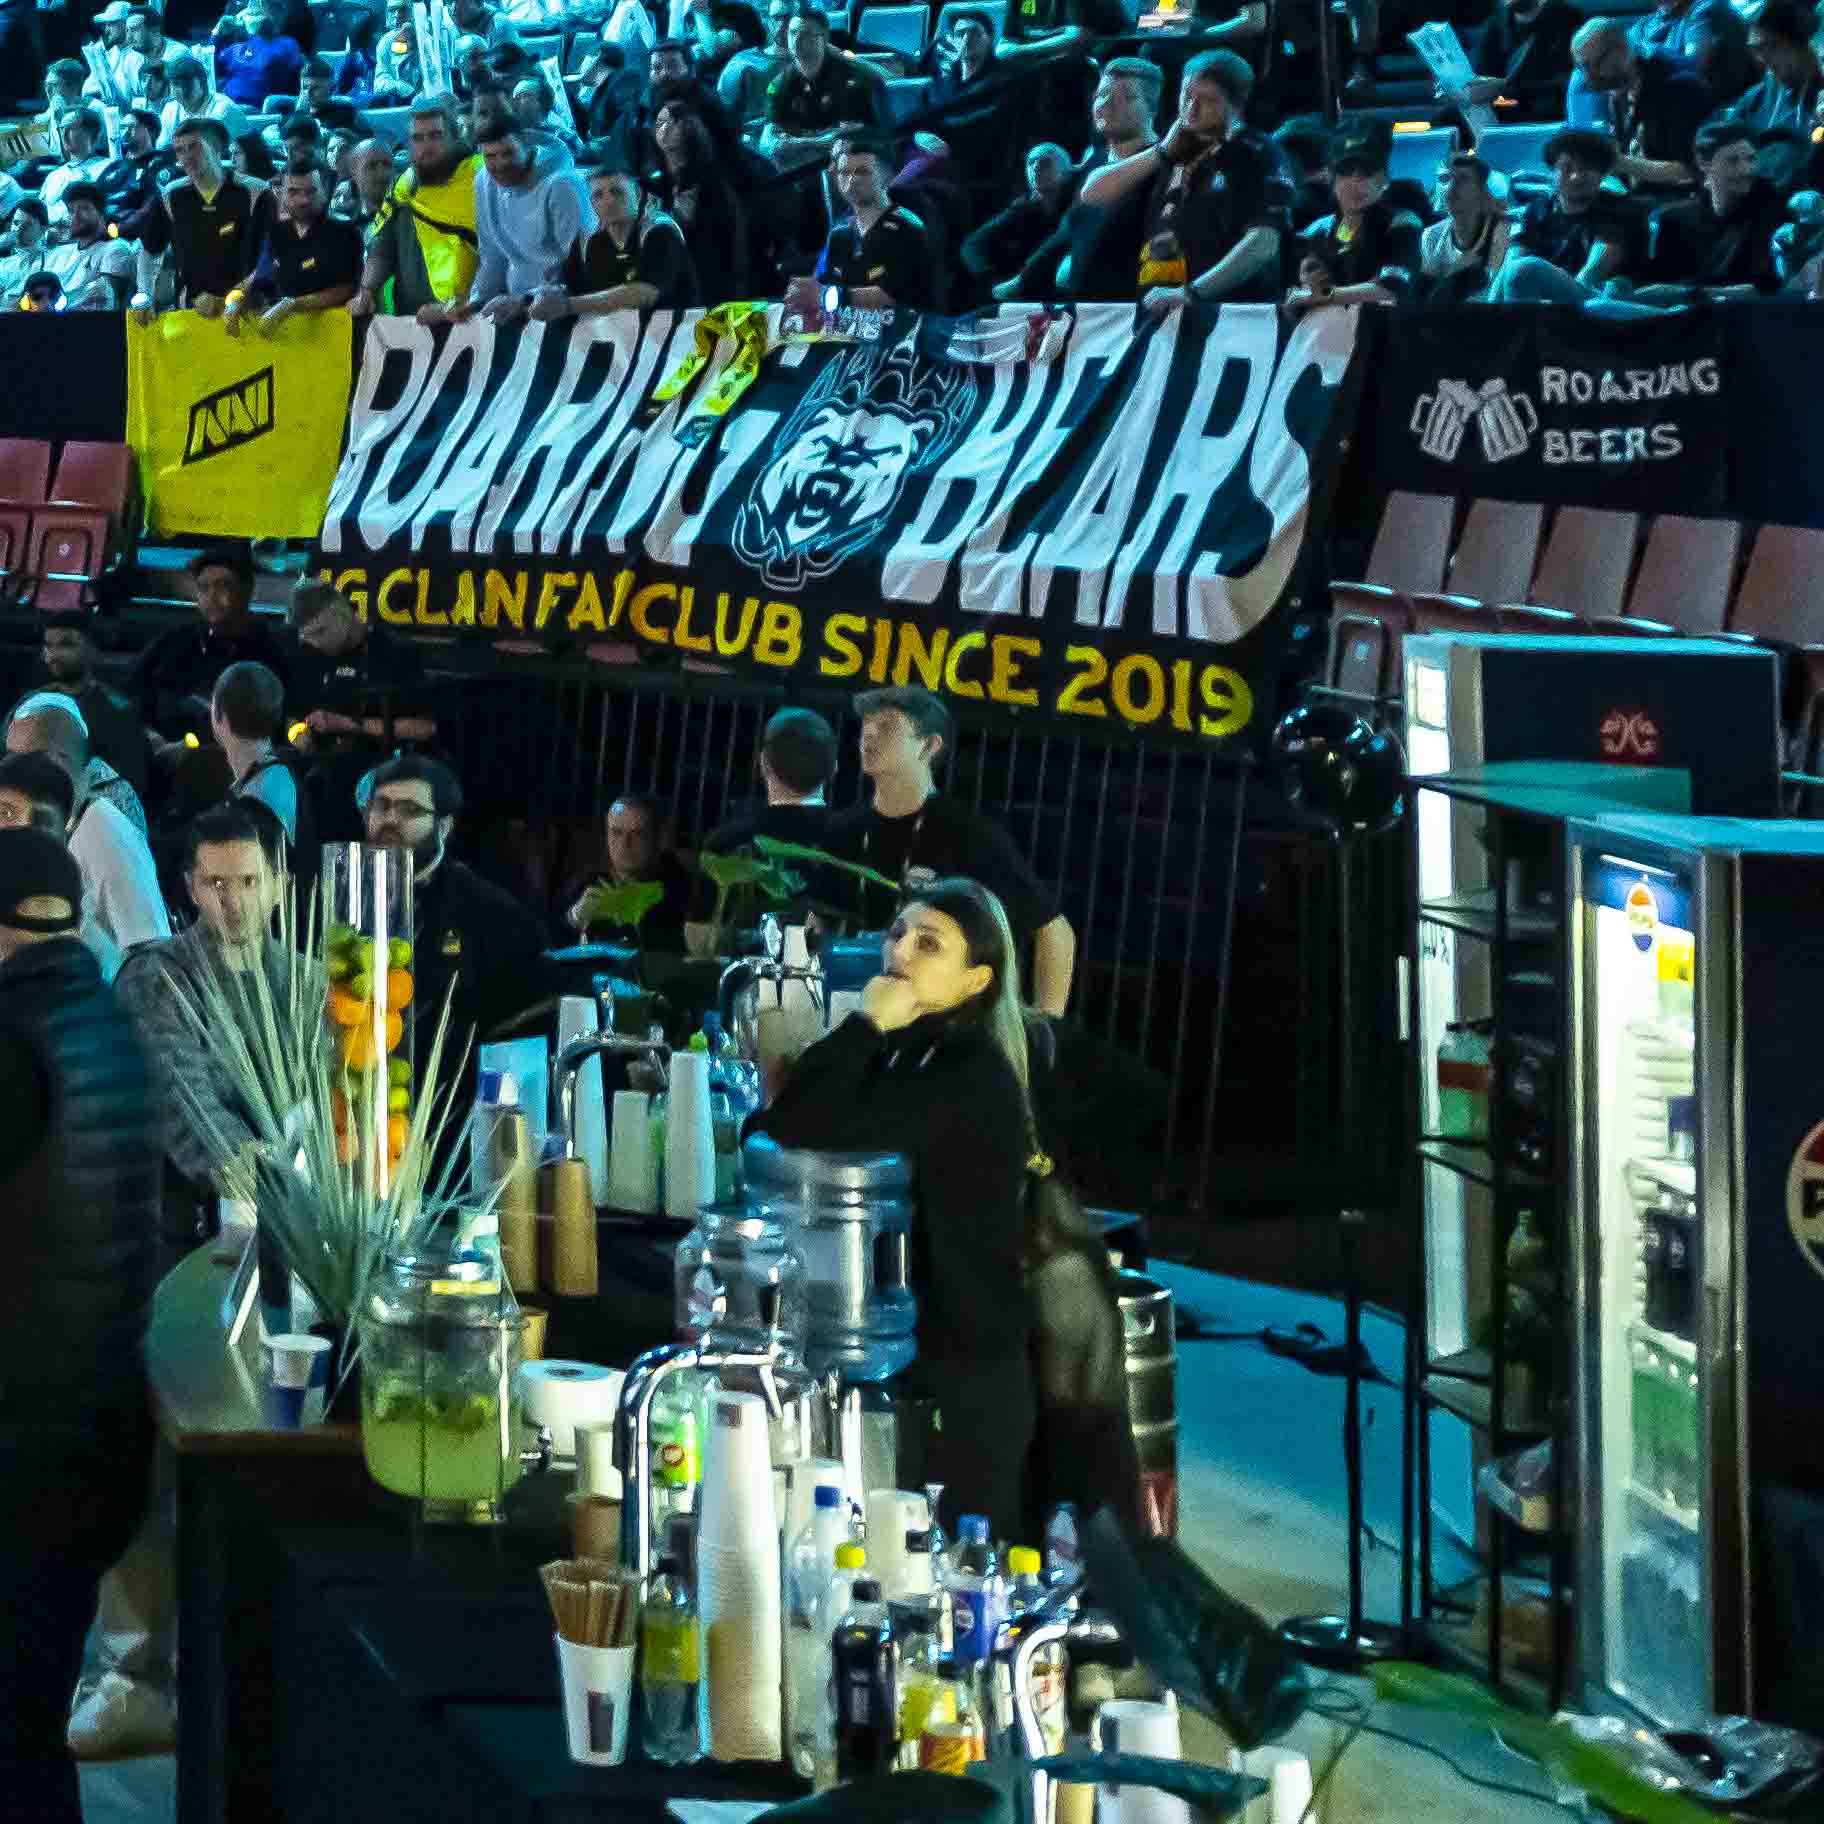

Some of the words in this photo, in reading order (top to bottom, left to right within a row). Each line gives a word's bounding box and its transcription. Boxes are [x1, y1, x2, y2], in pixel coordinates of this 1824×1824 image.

[1540, 358, 1721, 404] ROARING
[882, 303, 1358, 643] BEARS
[1541, 422, 1684, 466] BEERS
[378, 567, 529, 629] CLAN
[630, 583, 803, 667] CLUB
[819, 611, 1042, 708] SINCE
[1056, 642, 1255, 739] 2019
